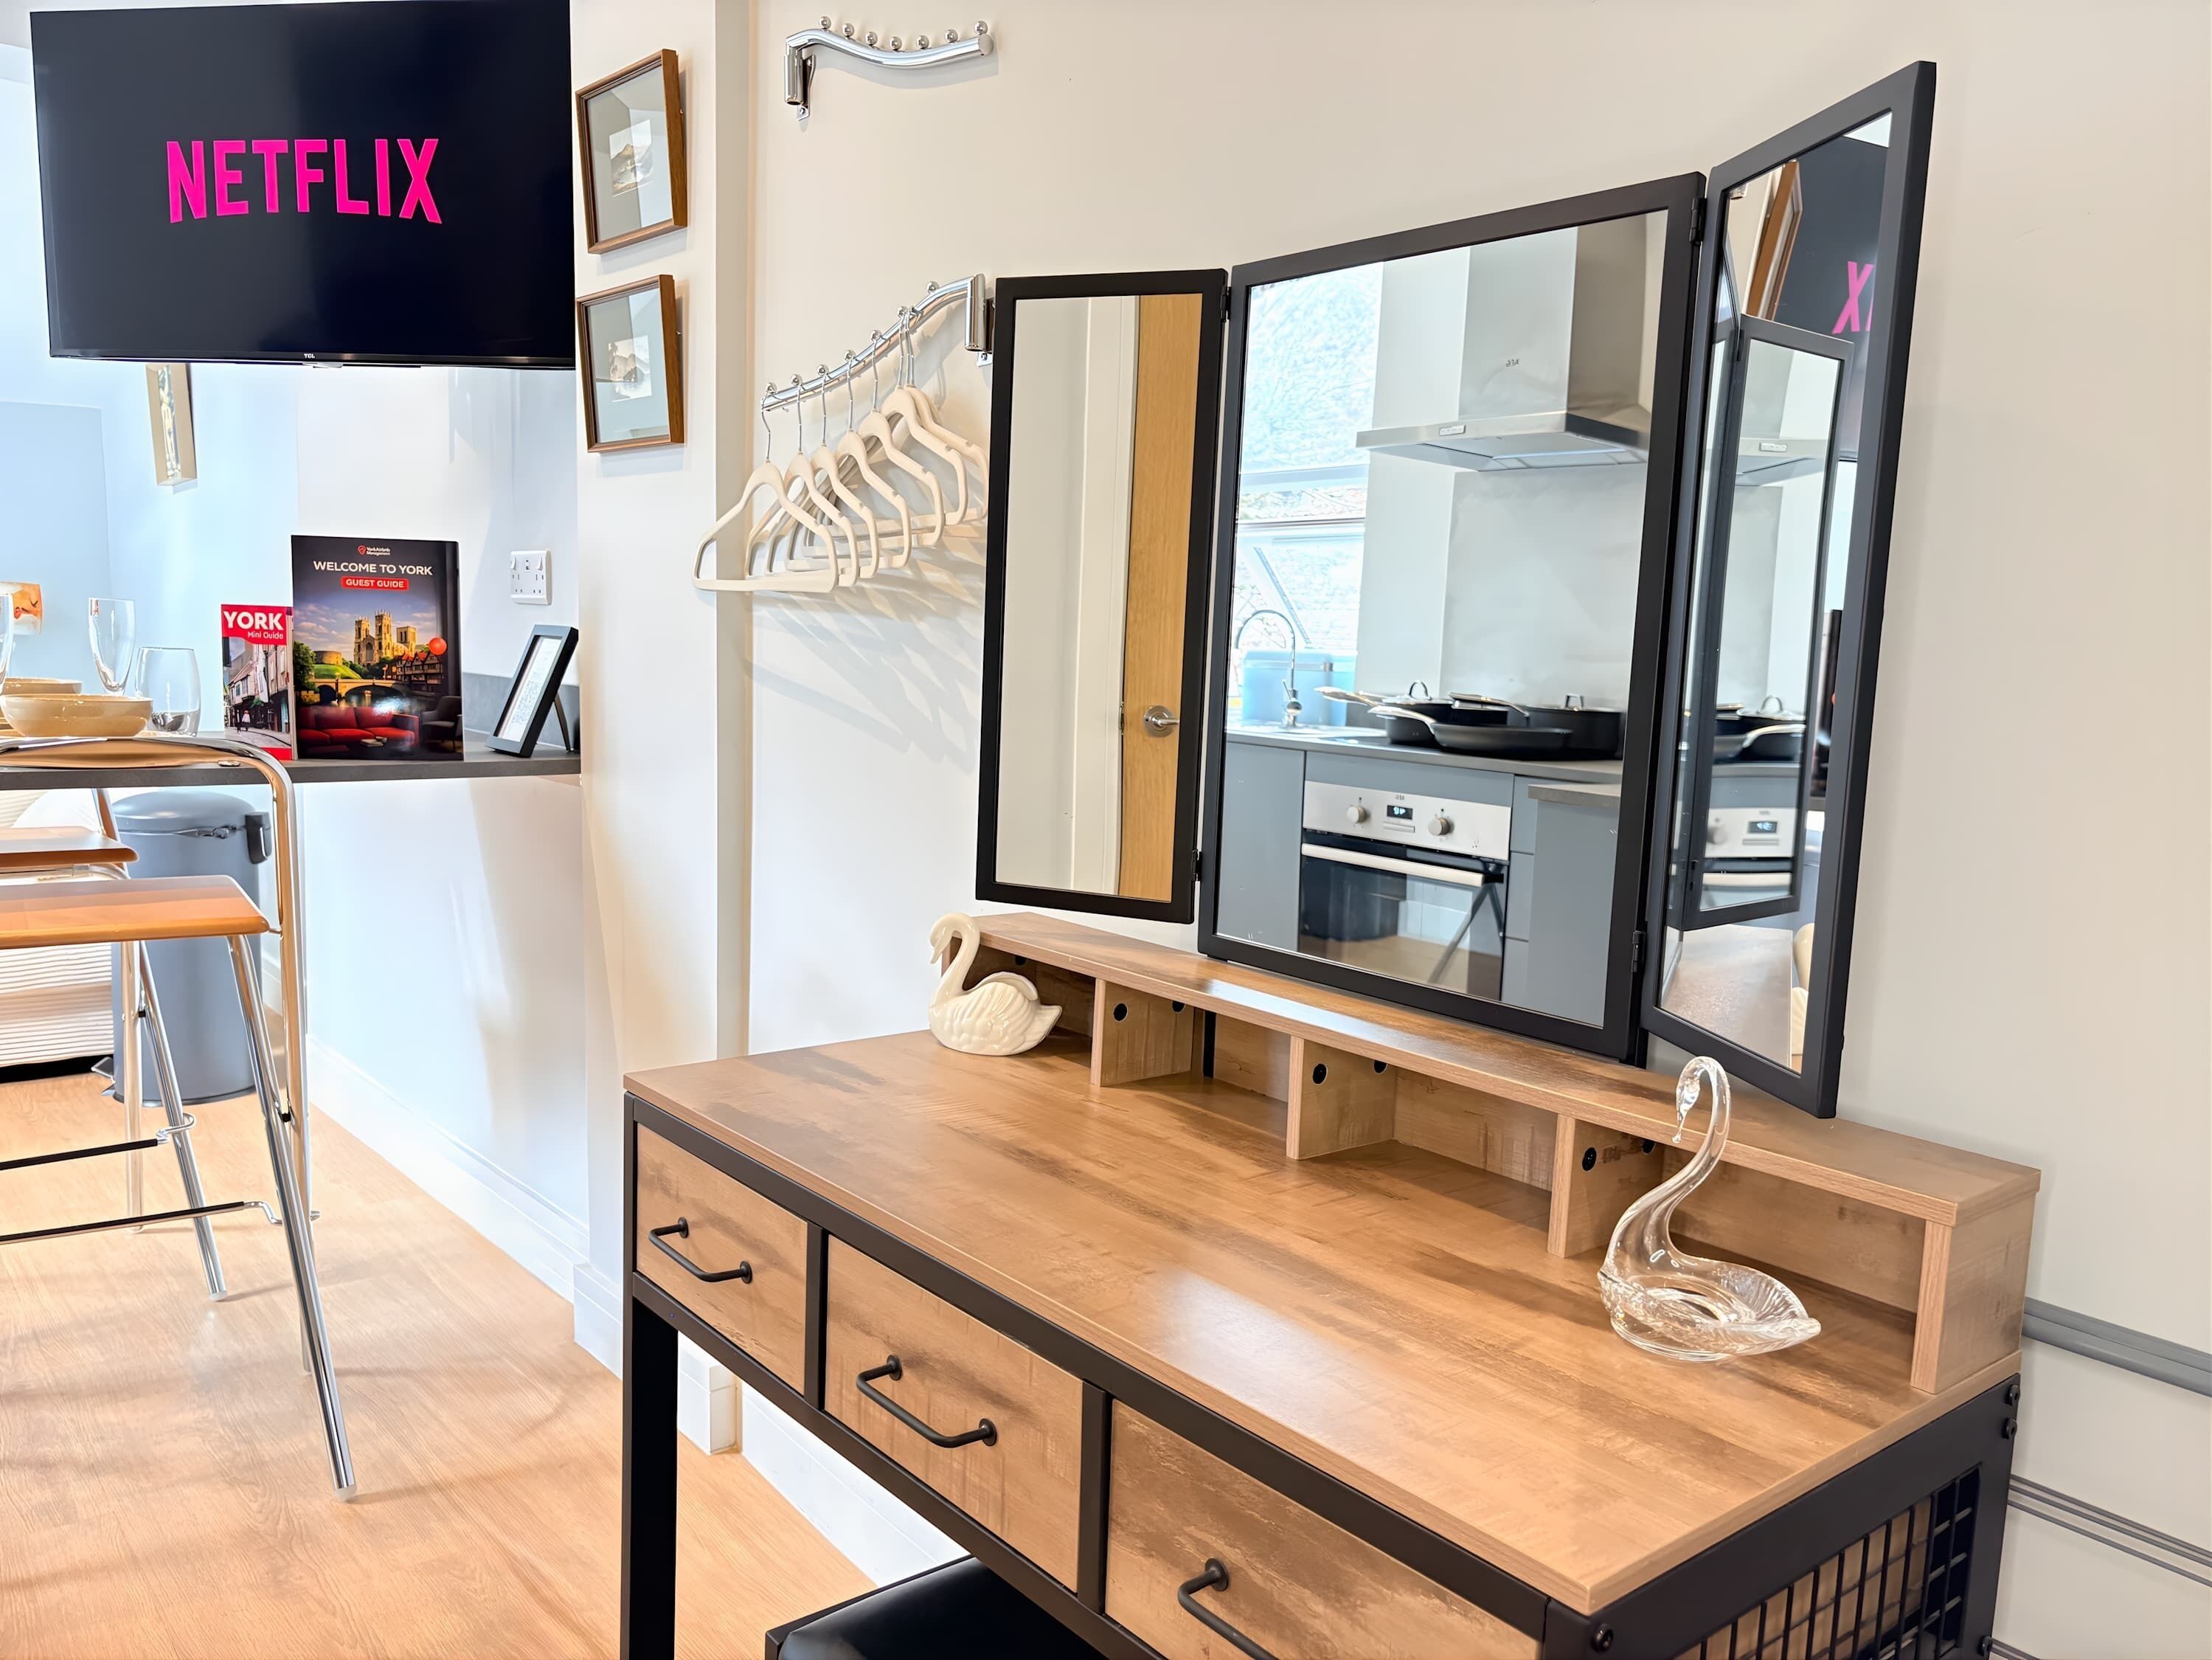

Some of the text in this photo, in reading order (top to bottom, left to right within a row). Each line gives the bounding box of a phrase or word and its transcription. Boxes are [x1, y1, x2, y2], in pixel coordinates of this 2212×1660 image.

[167, 139, 442, 224] NETFLIX
[313, 561, 433, 575] WELCOME TO YORK
[346, 578, 404, 588] GUEST GUIDE
[223, 611, 284, 631] YORK
